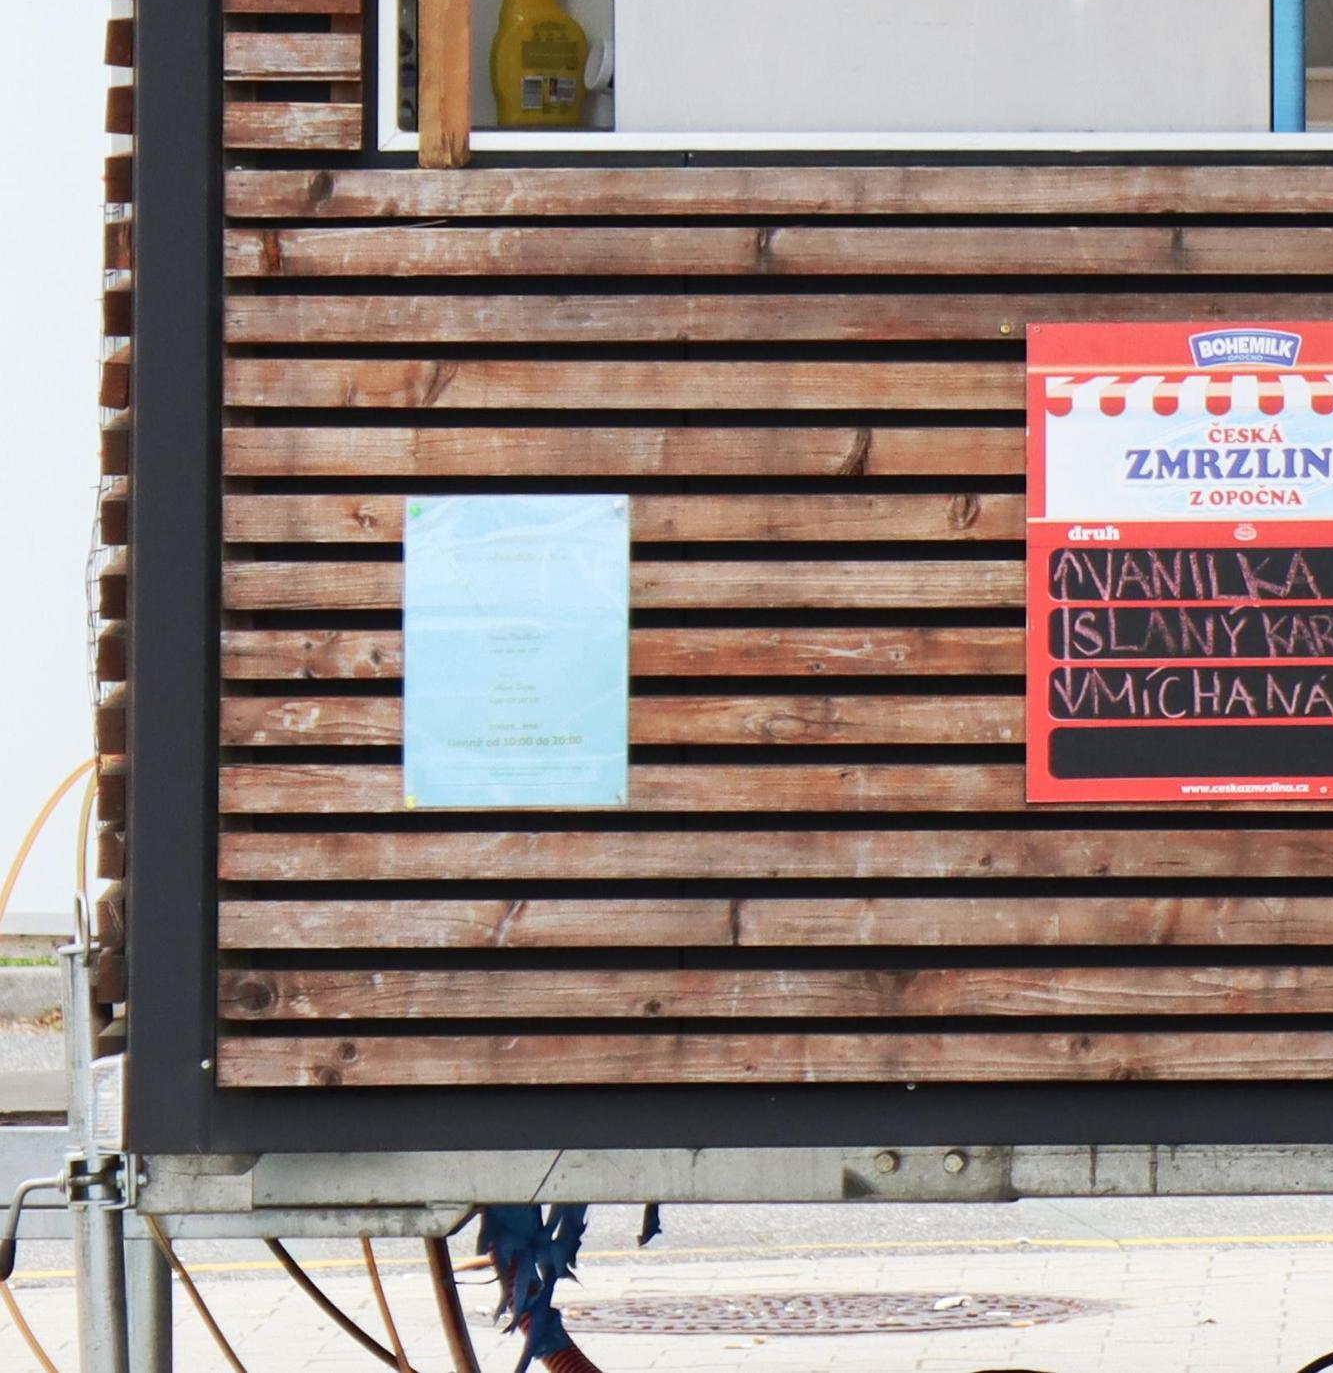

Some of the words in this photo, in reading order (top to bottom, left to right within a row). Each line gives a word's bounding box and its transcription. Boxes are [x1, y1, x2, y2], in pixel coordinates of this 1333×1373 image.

[1198, 336, 1294, 359] BOHEMILK
[1207, 423, 1283, 443] ČESKÁ
[1190, 491, 1203, 506] Z
[1209, 486, 1303, 505] OPOČNA
[1068, 526, 1121, 541] druh
[1181, 782, 1309, 793] www.ceskazmrzlina.cz
